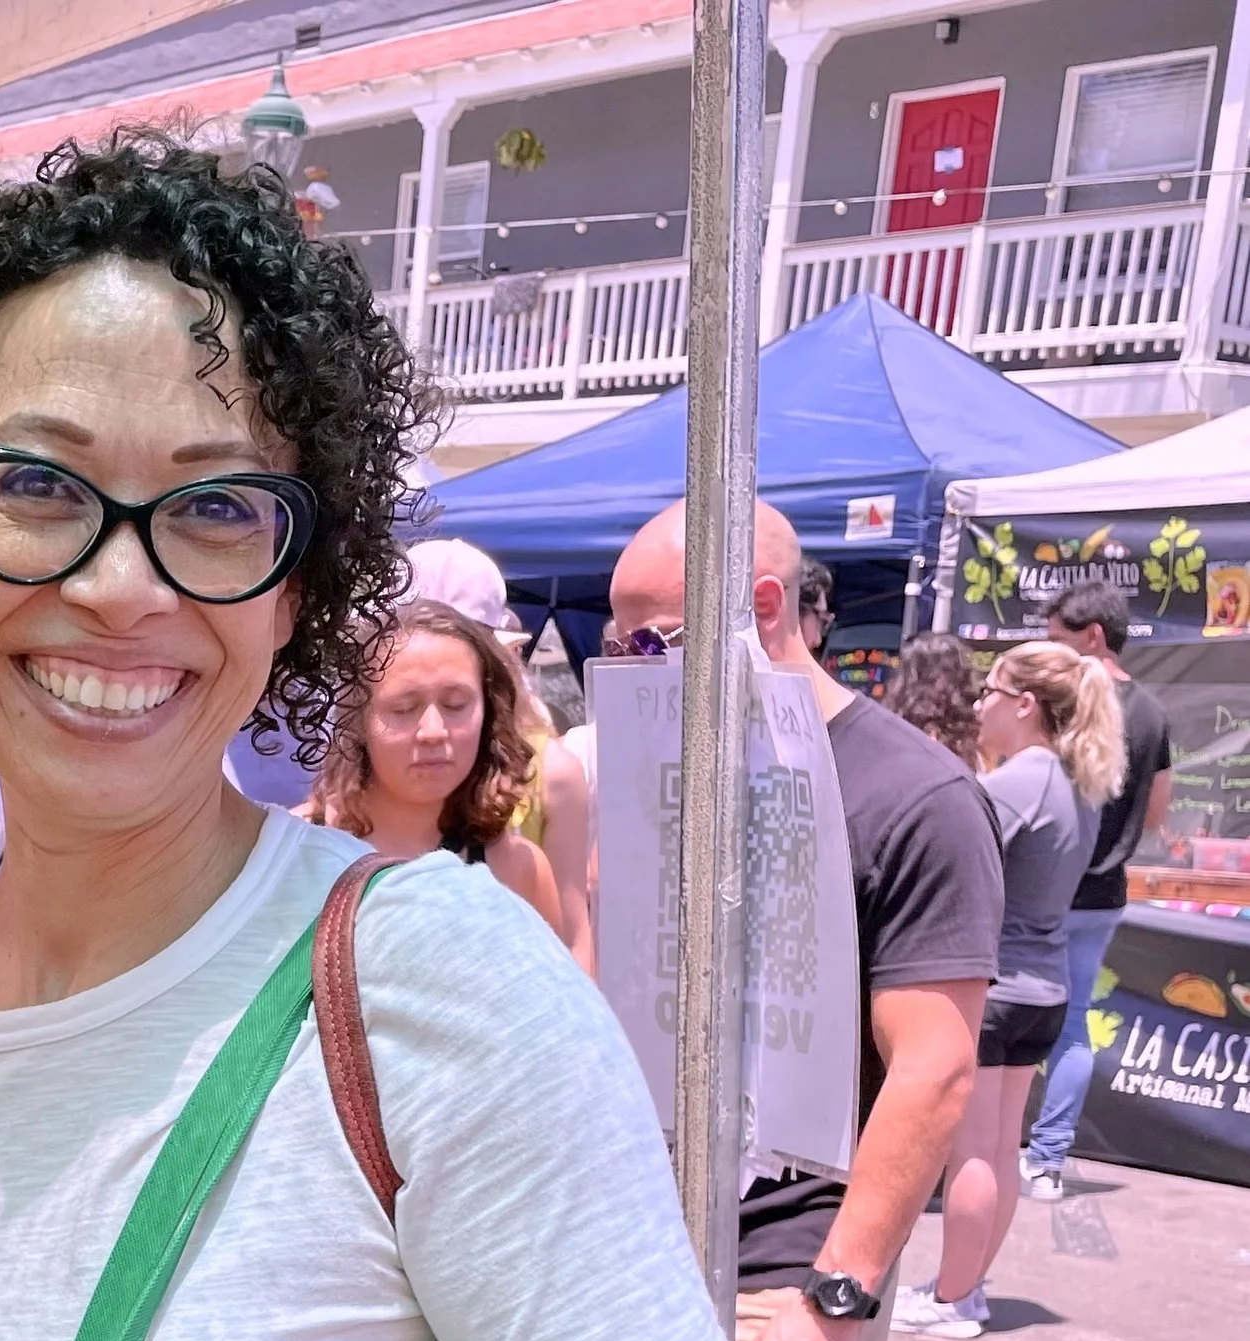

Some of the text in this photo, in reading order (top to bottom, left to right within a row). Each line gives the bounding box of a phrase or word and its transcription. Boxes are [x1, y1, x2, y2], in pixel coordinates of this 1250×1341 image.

[1019, 565, 1038, 589] LA
[1121, 1015, 1166, 1072] LA
[1110, 1068, 1226, 1109] Artisanal
